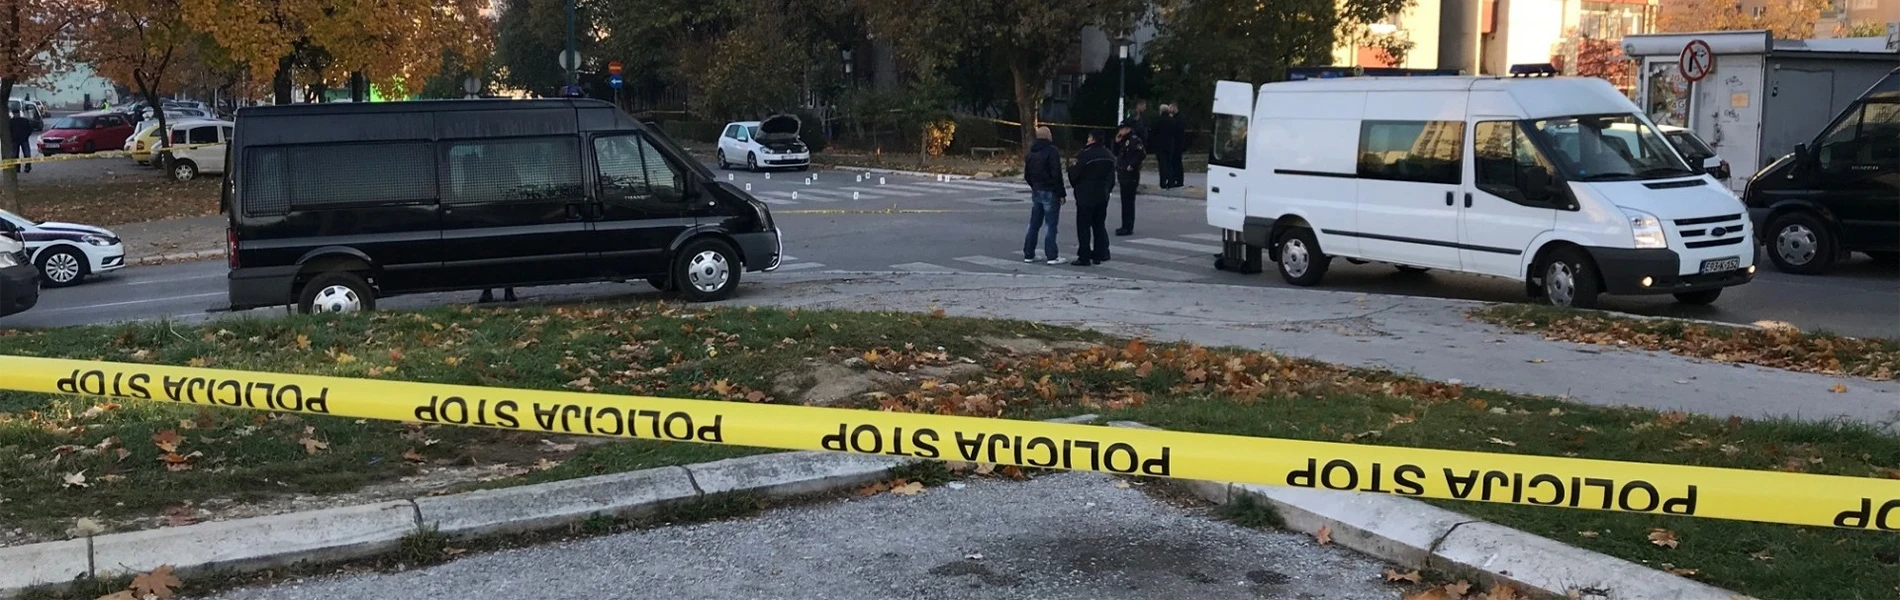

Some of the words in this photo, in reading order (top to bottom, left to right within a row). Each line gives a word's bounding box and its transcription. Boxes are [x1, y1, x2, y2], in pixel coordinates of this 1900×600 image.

[57, 369, 152, 399] STOP
[164, 374, 329, 415] POLICIJA
[415, 395, 519, 429] STOP
[533, 403, 723, 443] POLICIJA
[822, 423, 940, 459] STOP
[955, 432, 1171, 476] POLICIJA
[1287, 457, 1426, 497] STOP
[1443, 468, 1698, 517] POLICIJA
